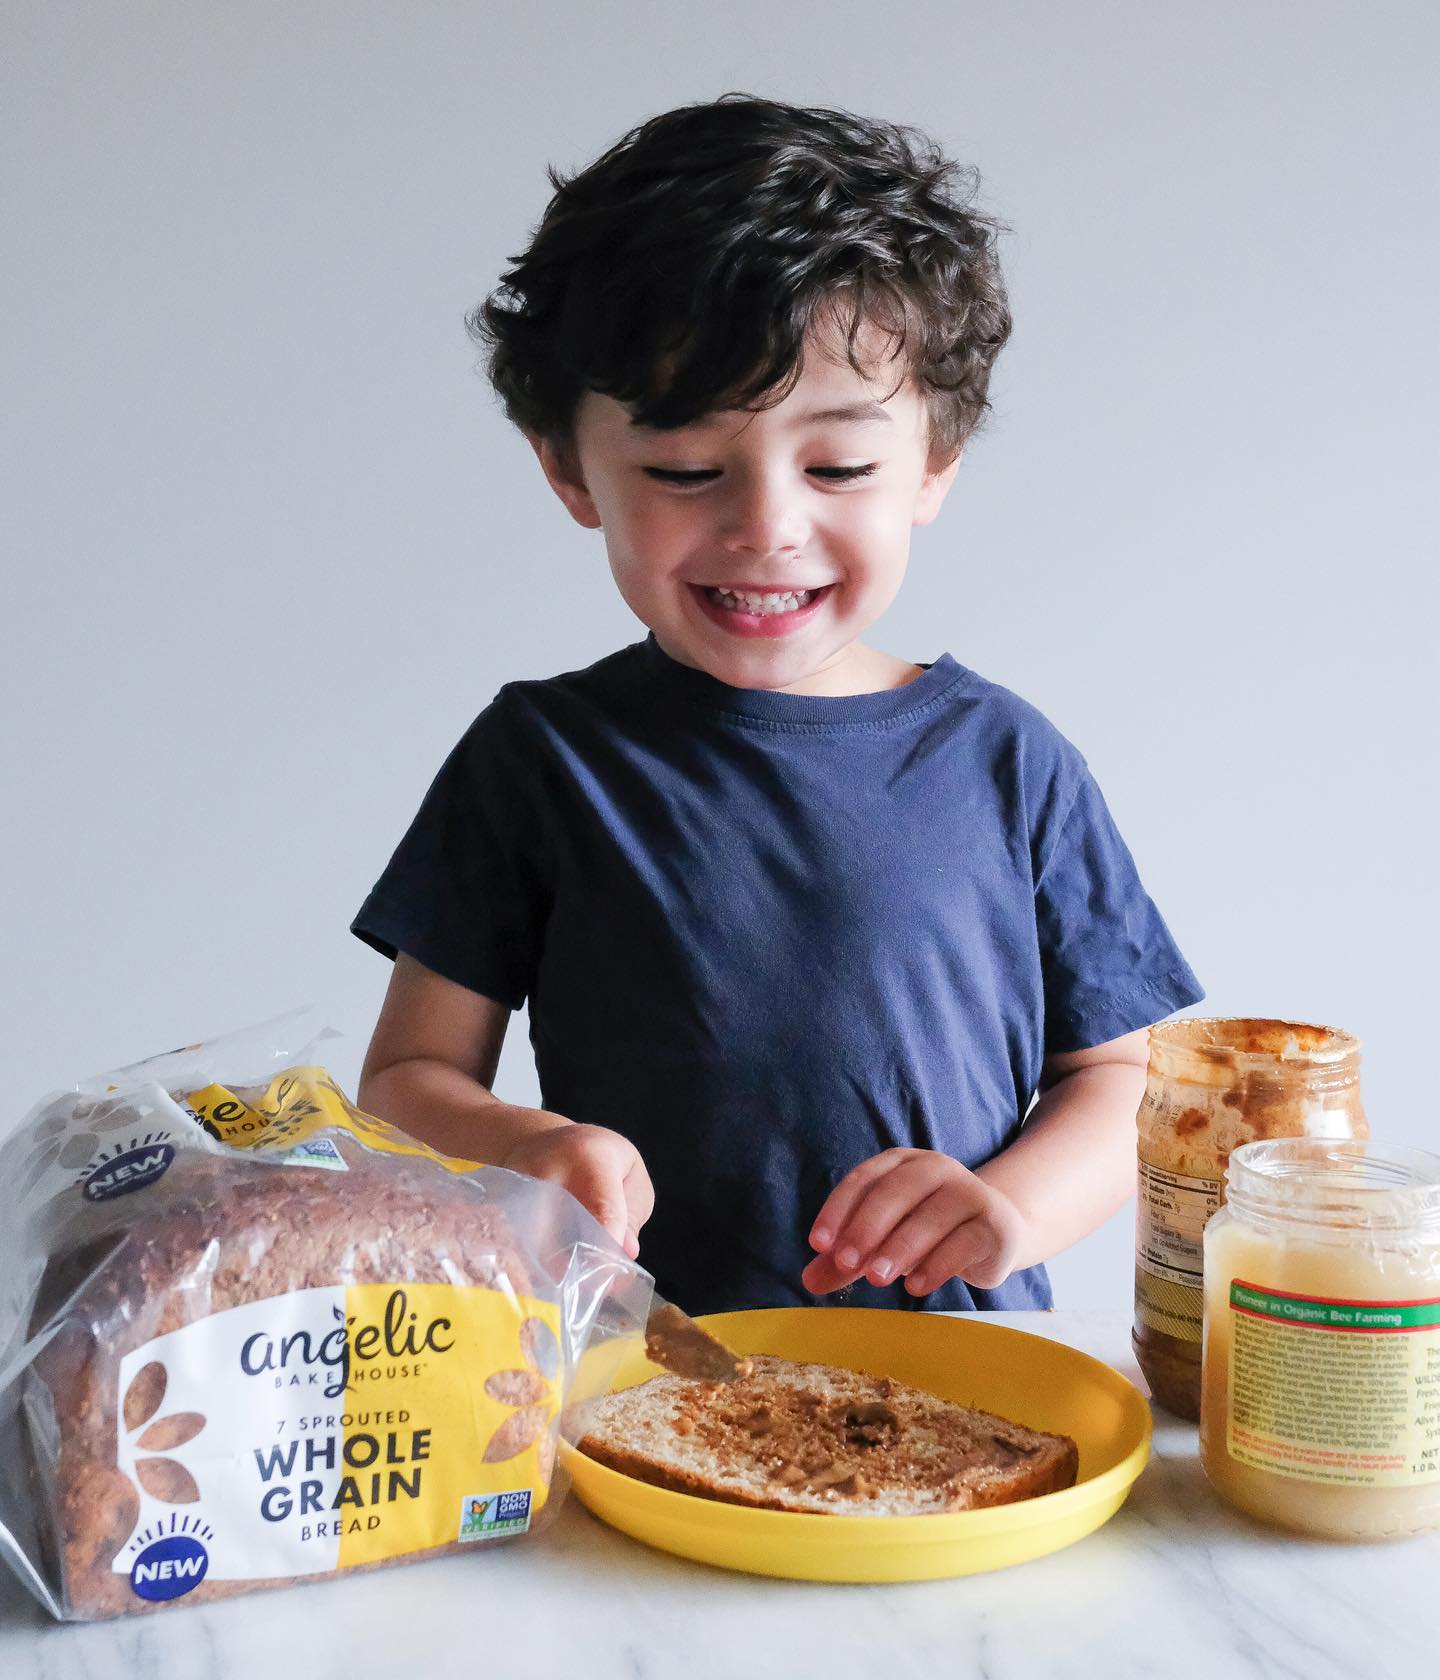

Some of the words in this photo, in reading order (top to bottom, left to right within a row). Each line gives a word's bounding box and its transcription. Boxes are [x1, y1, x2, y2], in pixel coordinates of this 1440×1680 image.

[88, 1147, 166, 1196] NEW
[1206, 1197, 1218, 1206] 0%
[1235, 1290, 1268, 1310] Pioneer
[1270, 1301, 1281, 1312] in
[1283, 1303, 1326, 1321] Organic
[1330, 1311, 1352, 1322] Bee
[1355, 1311, 1402, 1326] Farming
[241, 1290, 455, 1398] angelic
[275, 1371, 335, 1389] BAKE
[354, 1364, 423, 1383] HOUSE
[276, 1419, 287, 1435] 7
[300, 1410, 411, 1431] SPROUTED
[254, 1428, 432, 1482] WHOLE
[1421, 1448, 1439, 1459] NET
[1412, 1463, 1426, 1473] 1.0
[260, 1467, 422, 1523] GRAIN
[499, 1501, 528, 1513] GMO
[501, 1492, 529, 1504] NON
[301, 1515, 381, 1542] BREAD
[135, 1555, 205, 1585] NEW
